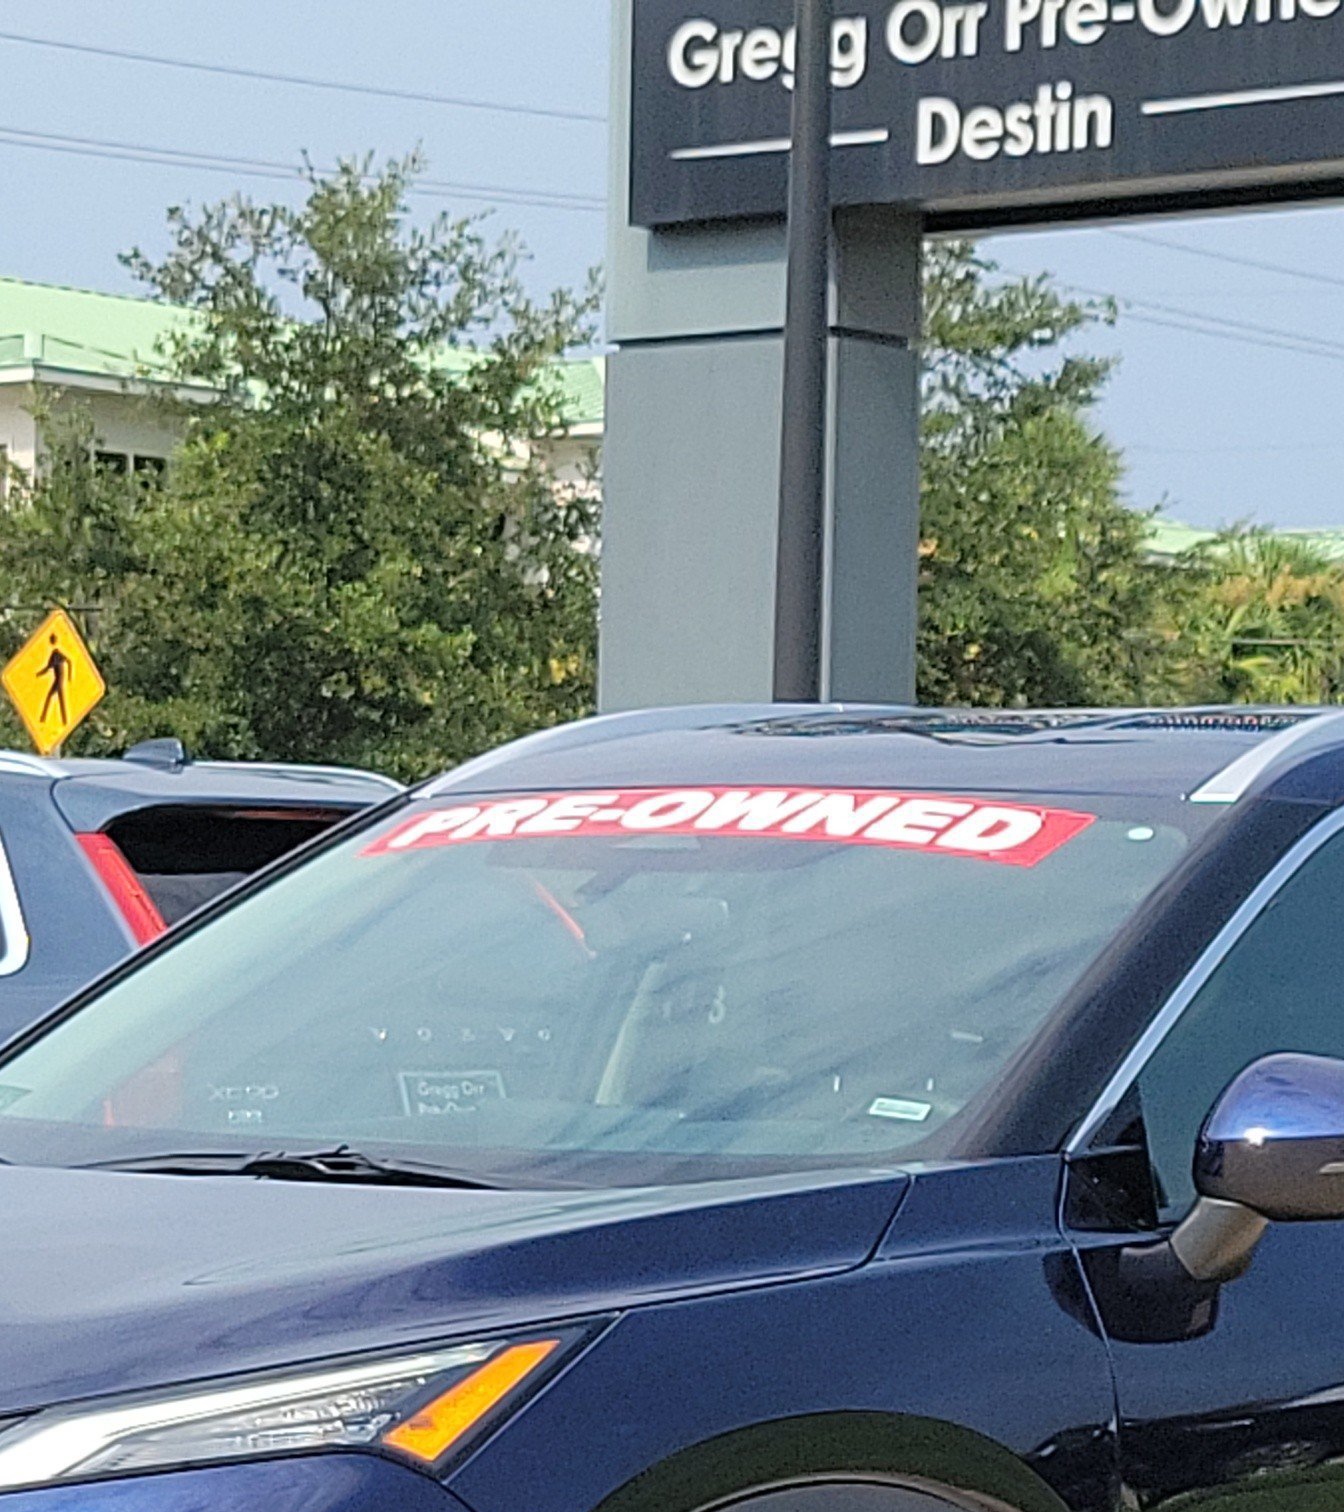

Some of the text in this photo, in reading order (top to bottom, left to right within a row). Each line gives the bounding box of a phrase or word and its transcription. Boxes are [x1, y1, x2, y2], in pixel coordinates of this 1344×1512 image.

[886, 0, 989, 64] Orr
[916, 80, 1113, 165] Destin
[387, 789, 1045, 851] PRE-OWNED
